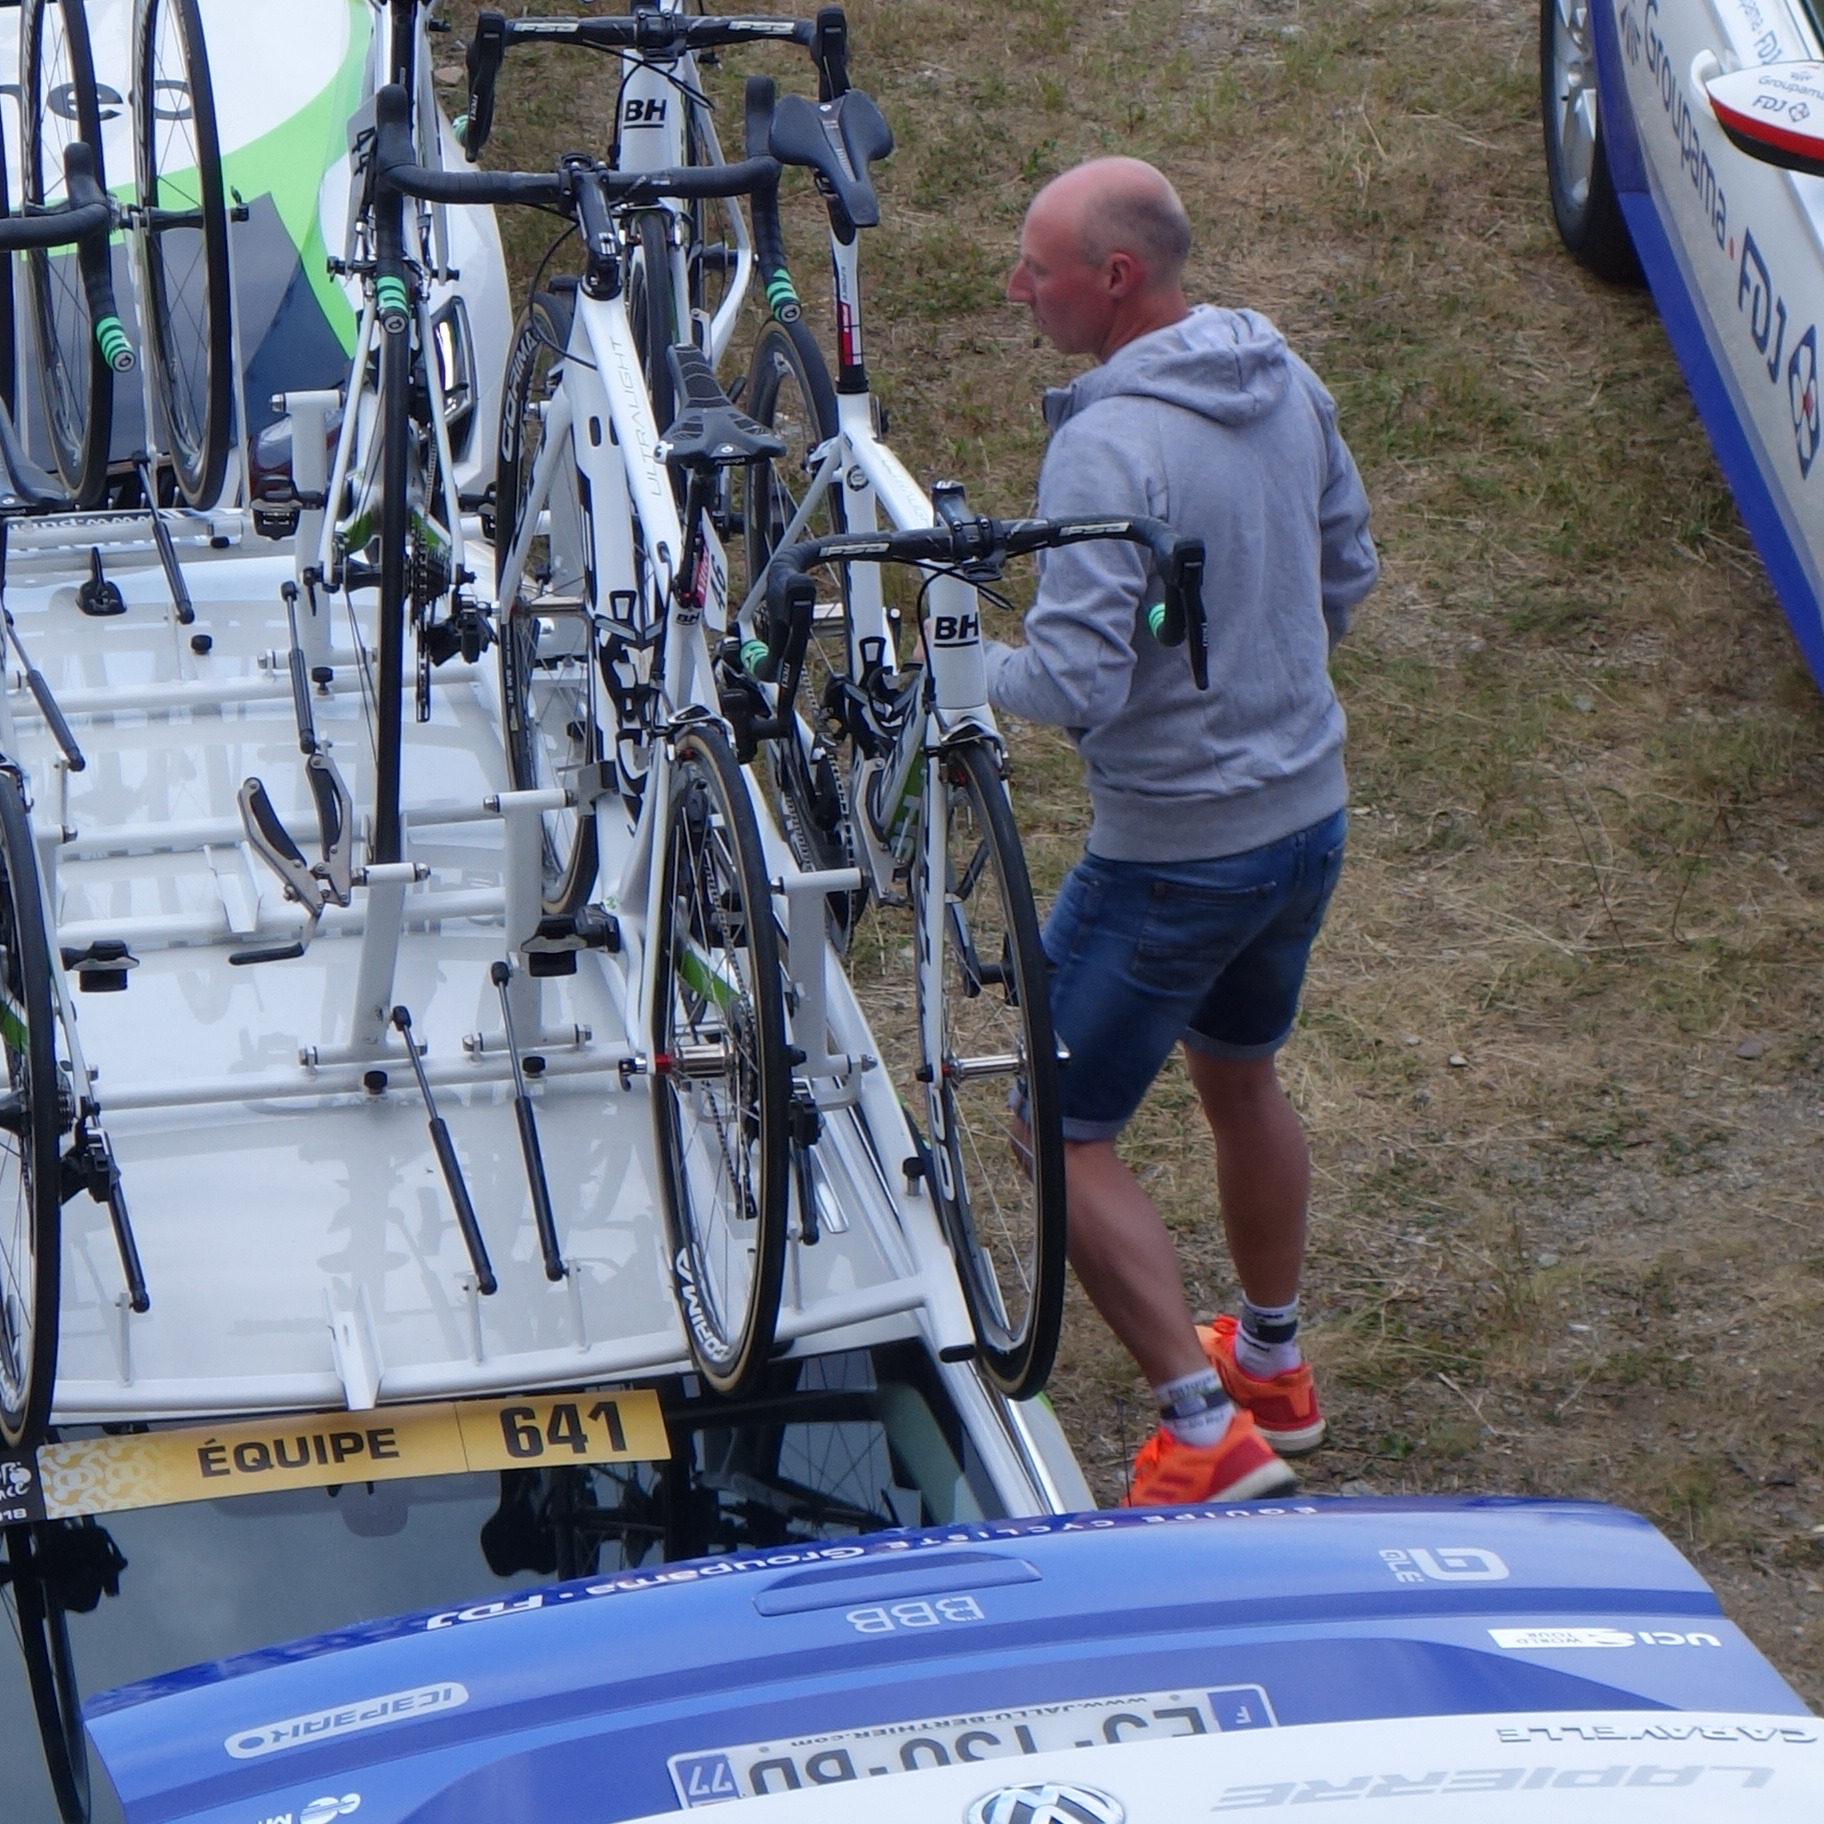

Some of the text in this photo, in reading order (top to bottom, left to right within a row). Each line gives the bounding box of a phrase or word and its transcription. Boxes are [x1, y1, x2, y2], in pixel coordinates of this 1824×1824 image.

[625, 98, 667, 123] BH
[1751, 94, 1789, 113] FDJ
[1737, 226, 1787, 386] FDJ
[501, 327, 540, 462] CORIMA
[608, 334, 665, 497] ULTRALIGHT
[1058, 521, 1131, 538] FSA
[933, 613, 980, 642] BH
[196, 1400, 630, 1479] ÉQUIPE 641
[887, 1520, 1117, 1551] CYCLISTE
[585, 1545, 866, 1597] Groupama
[426, 1593, 543, 1630] FDJ
[844, 1595, 986, 1634] BBB
[1639, 1630, 1723, 1648] UCI
[789, 1695, 1148, 1749] www.JALLU-BERTHIER.com
[1235, 1704, 1252, 1725] F
[1496, 1726, 1819, 1745] CARAVELLE
[687, 1761, 736, 1795] 77
[1209, 1765, 1779, 1813] LAPIERRE
